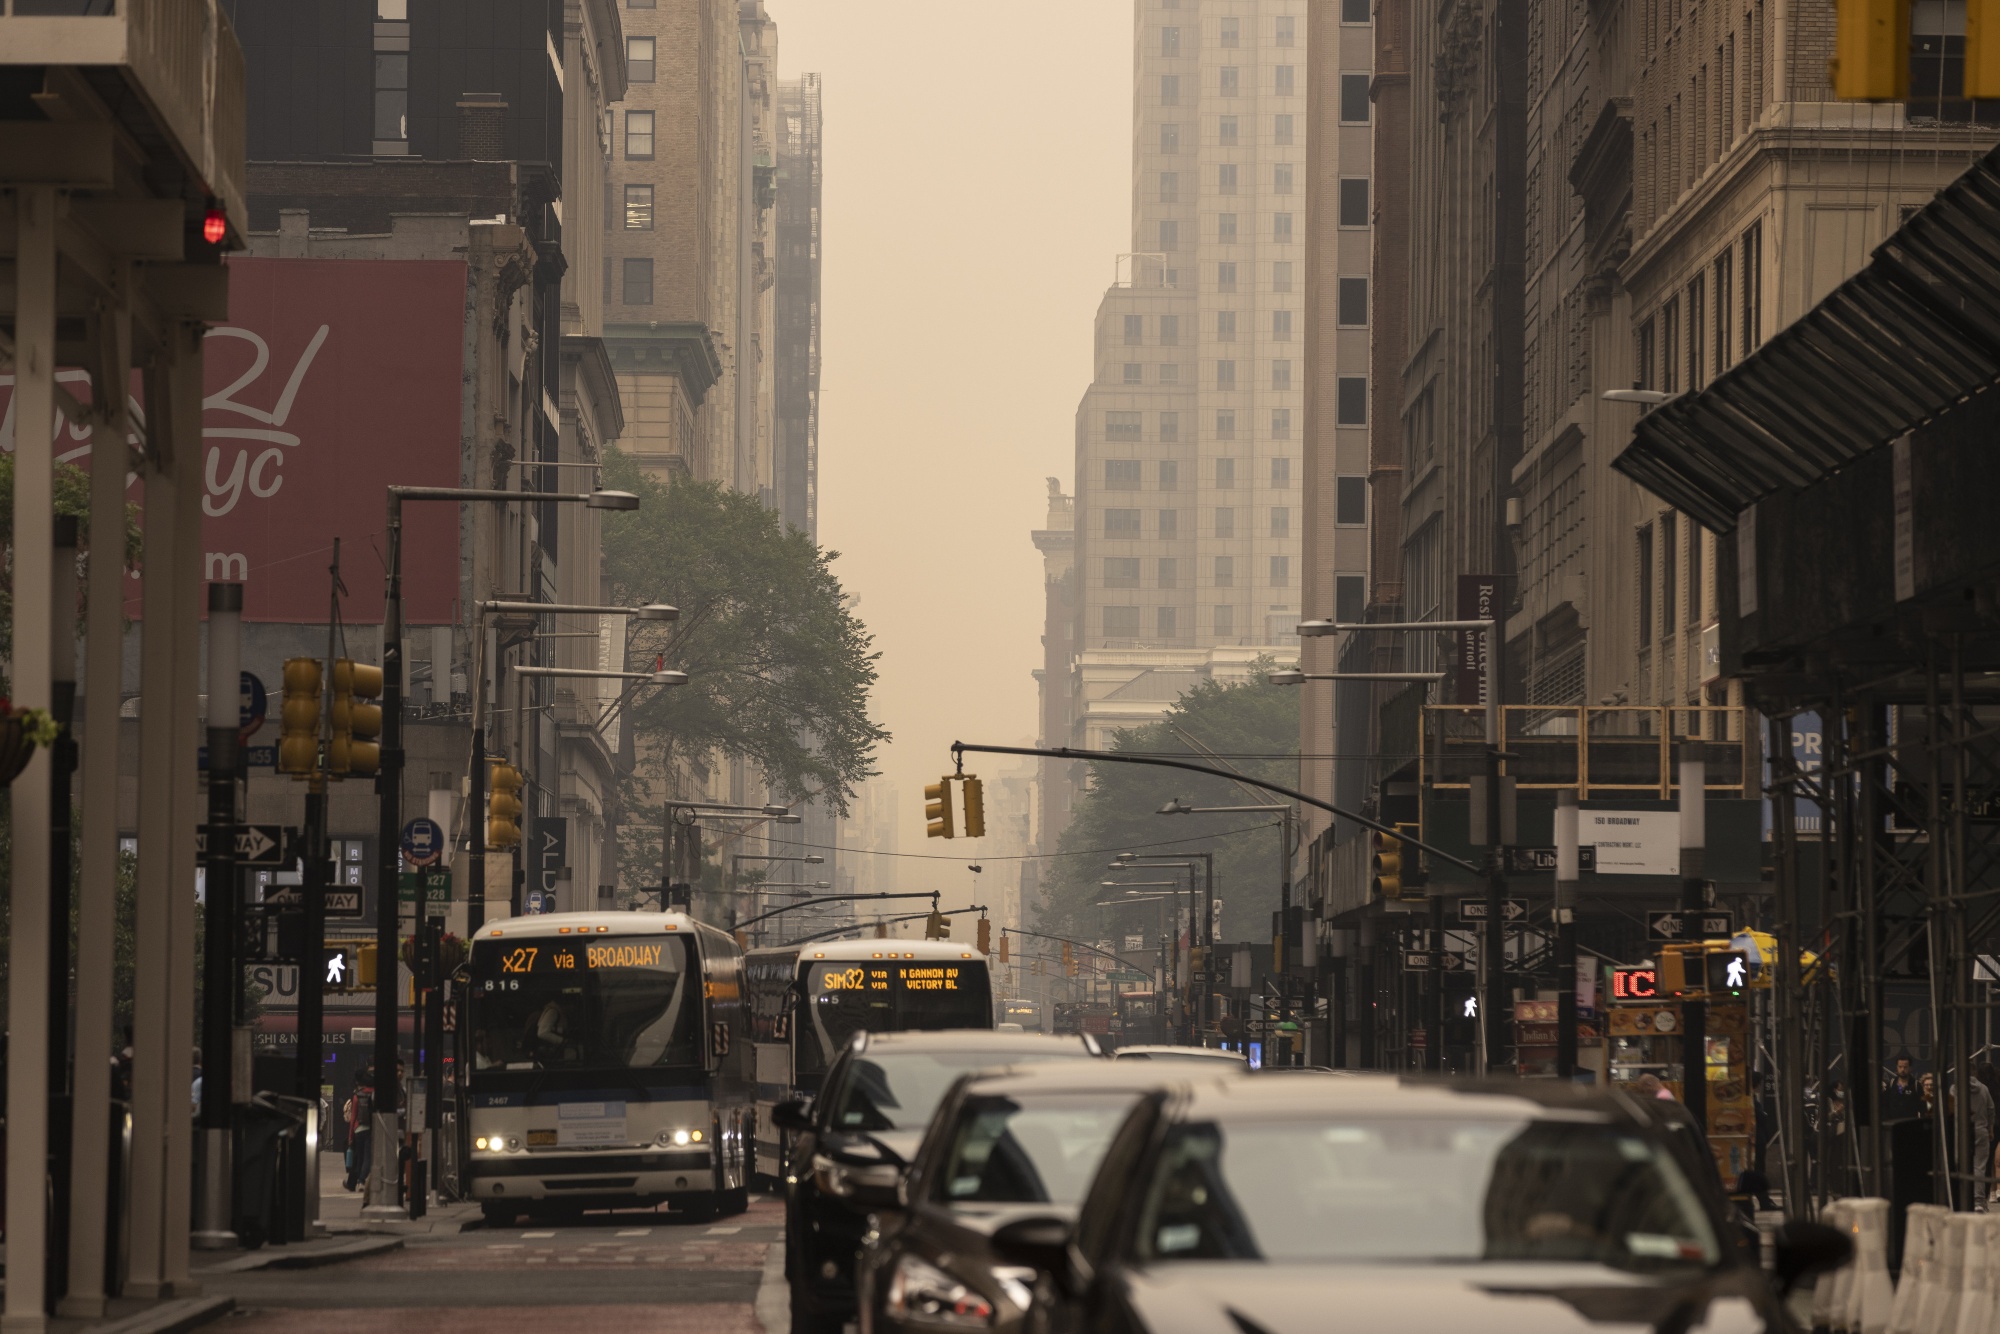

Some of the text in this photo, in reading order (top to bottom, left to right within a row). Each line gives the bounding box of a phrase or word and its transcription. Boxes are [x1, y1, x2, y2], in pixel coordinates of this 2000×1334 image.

[202, 446, 284, 517] yc
[1479, 584, 1494, 671] Resience
[248, 749, 273, 763] M55
[1595, 817, 1640, 826] 150 BROADWAY
[1582, 853, 1590, 861] ST
[427, 875, 446, 886] x27
[427, 889, 446, 900] x28
[1705, 921, 1721, 931] AY
[502, 945, 661, 973] x27 via BROADWAY
[824, 968, 958, 990] SIM32 VIA N GANNON AV
[871, 980, 958, 990] VIA VICTORY BL
[279, 1034, 288, 1043] &
[488, 1097, 508, 1105] 2467
